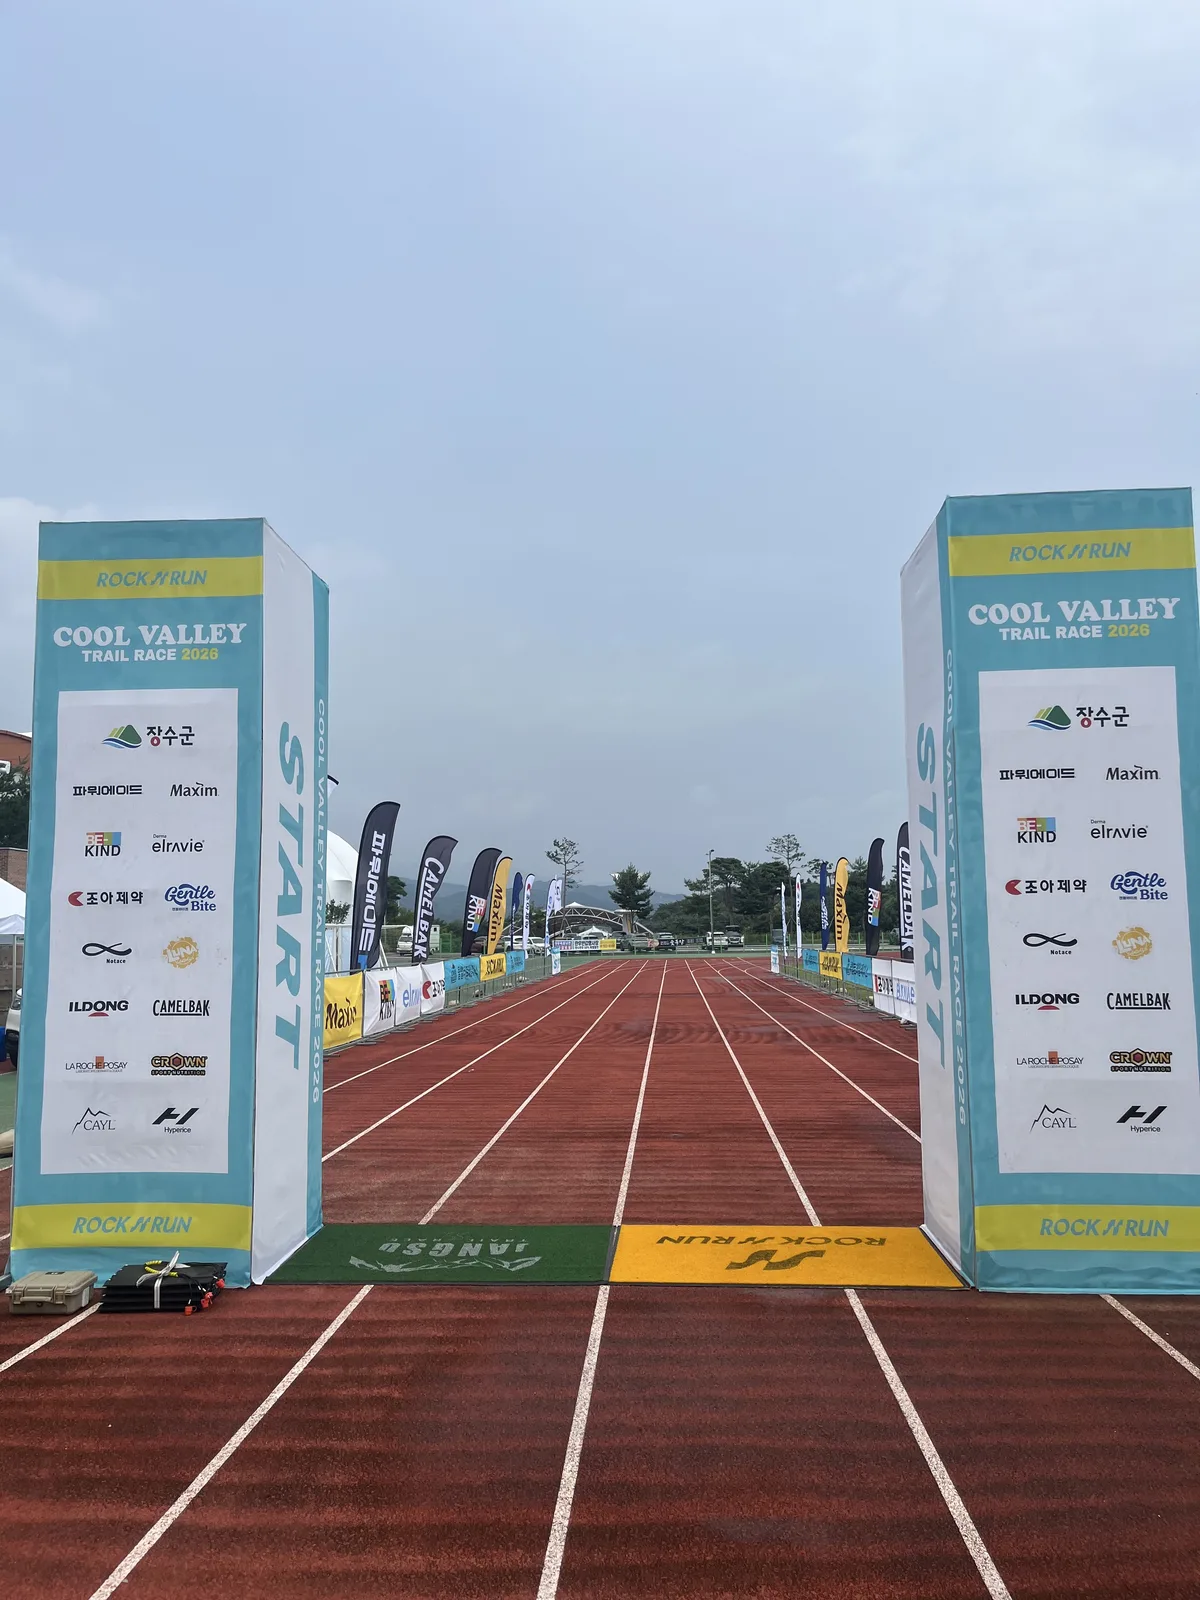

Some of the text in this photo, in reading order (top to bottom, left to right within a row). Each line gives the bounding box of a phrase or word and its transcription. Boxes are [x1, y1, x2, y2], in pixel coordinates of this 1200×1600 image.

[1009, 544, 1067, 562] ROCK
[1089, 542, 1132, 559] RUN
[96, 571, 150, 587] ROCK
[170, 570, 208, 586] RUN
[968, 597, 1180, 625] COOL VALLEY
[53, 623, 247, 647] COOL VALLEY
[999, 624, 1150, 641] TRAIL RACE 2026
[82, 648, 219, 662] TRAIL RACE 2026
[1075, 706, 1130, 728] 장수군
[146, 725, 195, 747] 장수군
[999, 767, 1075, 780] 파워에이드
[1105, 765, 1159, 780] Maxim
[73, 784, 143, 796] 파워에이드
[170, 782, 218, 797] Maxim
[1017, 831, 1057, 843] KIND
[84, 845, 121, 857] KIND
[359, 830, 386, 952] 파워에이드
[1025, 879, 1087, 894] 조아제약
[1110, 871, 1167, 895] Gentle
[86, 891, 144, 906] 조아제약
[164, 883, 216, 906] Gentle
[275, 721, 305, 1070] START
[312, 699, 325, 1103] COOL VALLEY TRAIL RACE 2026
[917, 722, 945, 1069] START
[1140, 889, 1168, 900] Bite
[191, 900, 216, 912] Bite
[414, 857, 444, 958] CAMELBAK
[466, 894, 478, 931] KIND
[490, 883, 503, 942] Maxim
[836, 882, 847, 941] Maxim
[867, 887, 876, 924] KIND
[949, 860, 957, 946] TRAIL
[953, 955, 962, 1037] RACE
[69, 1000, 129, 1012] ILDONG
[1015, 993, 1080, 1005] ILDONG
[1106, 992, 1171, 1010] CAMELBAK
[152, 999, 210, 1017] CAMELBAK
[151, 1052, 206, 1070] CROWN
[1110, 1047, 1170, 1066] CROWN
[83, 1119, 115, 1131] CAYL
[164, 1126, 192, 1134] Hyperice
[1042, 1117, 1076, 1129] CAYL
[1130, 1125, 1161, 1133] Hyperice
[73, 1216, 130, 1233] ROCK
[150, 1217, 192, 1233] RUN
[1039, 1218, 1101, 1236] ROCK
[1124, 1219, 1169, 1237] RUN
[656, 1235, 736, 1245] RUN
[780, 1236, 887, 1246] ROCK
[378, 1242, 529, 1257] JANGSU
